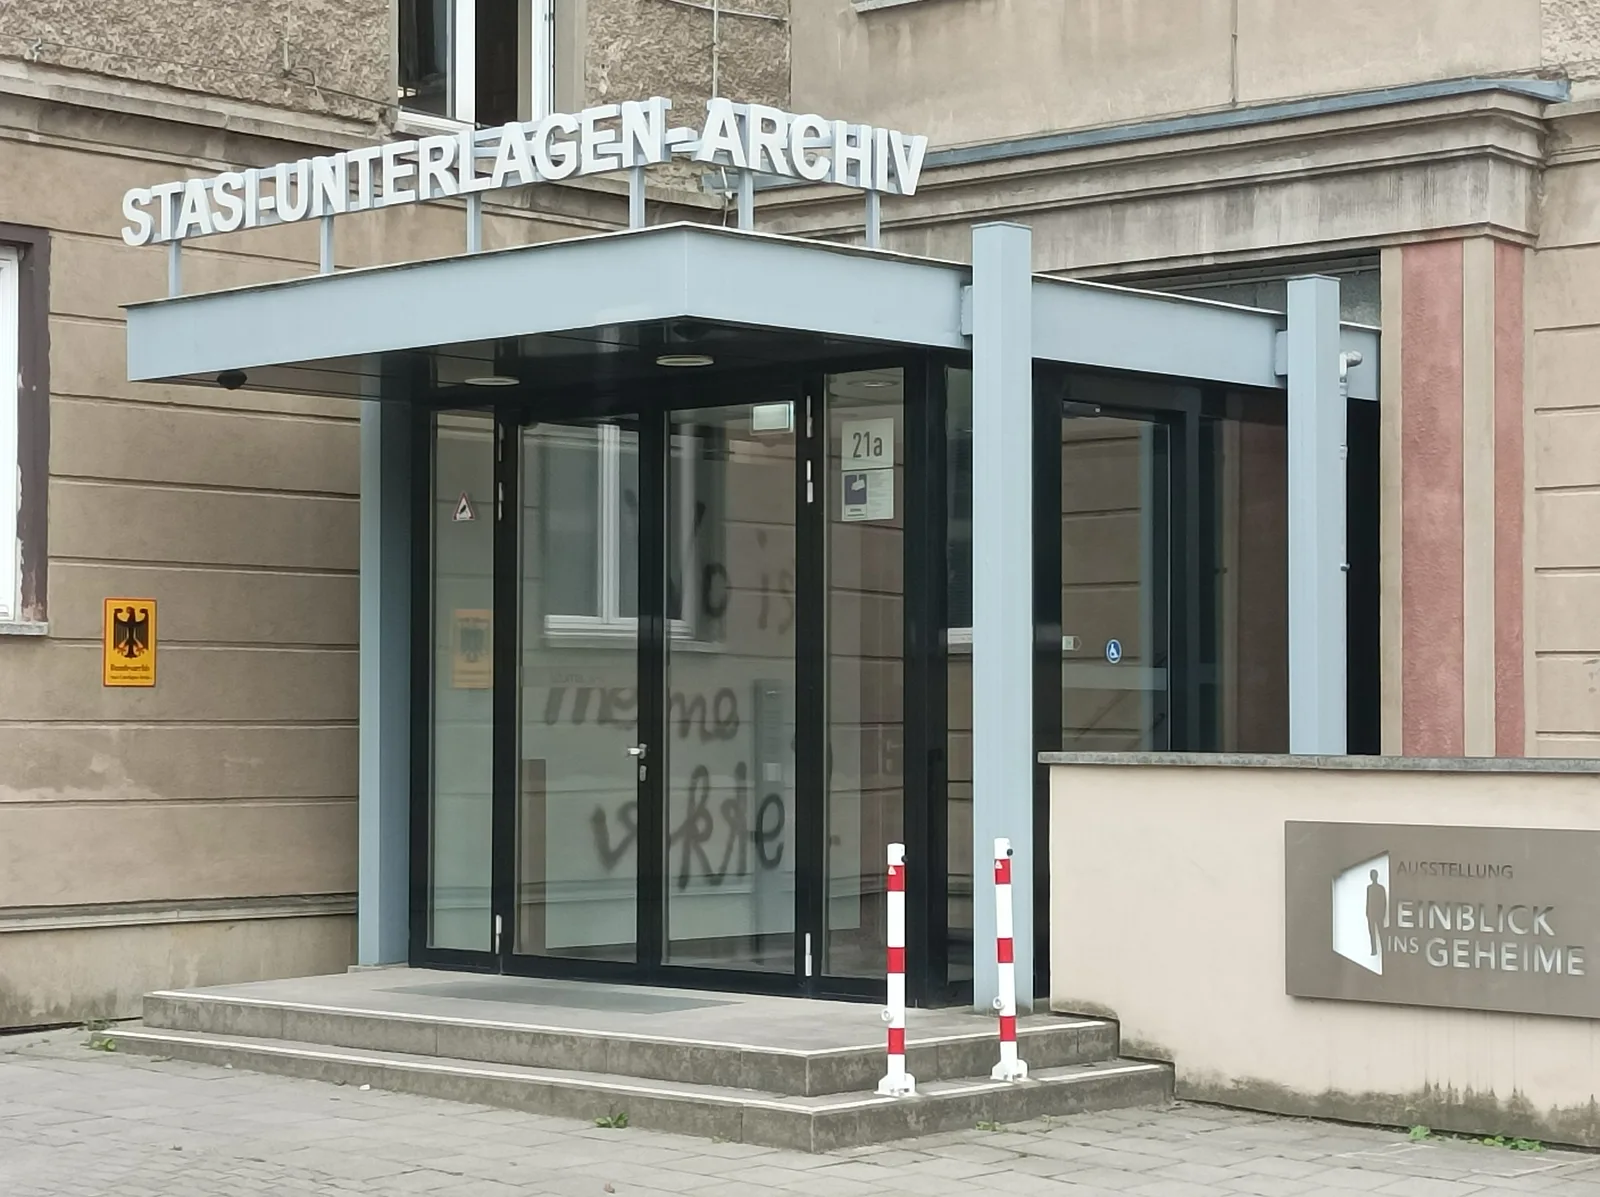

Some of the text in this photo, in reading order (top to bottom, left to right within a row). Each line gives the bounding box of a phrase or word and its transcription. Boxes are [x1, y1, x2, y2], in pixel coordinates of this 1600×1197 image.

[121, 96, 928, 247] STASI-UNTERLAGEN-ARCHIV
[852, 431, 883, 458] 21a
[1397, 861, 1514, 879] AUSSTELLUNG
[1397, 900, 1556, 937] EINBLICK
[1387, 935, 1586, 976] INS GEHEIME
